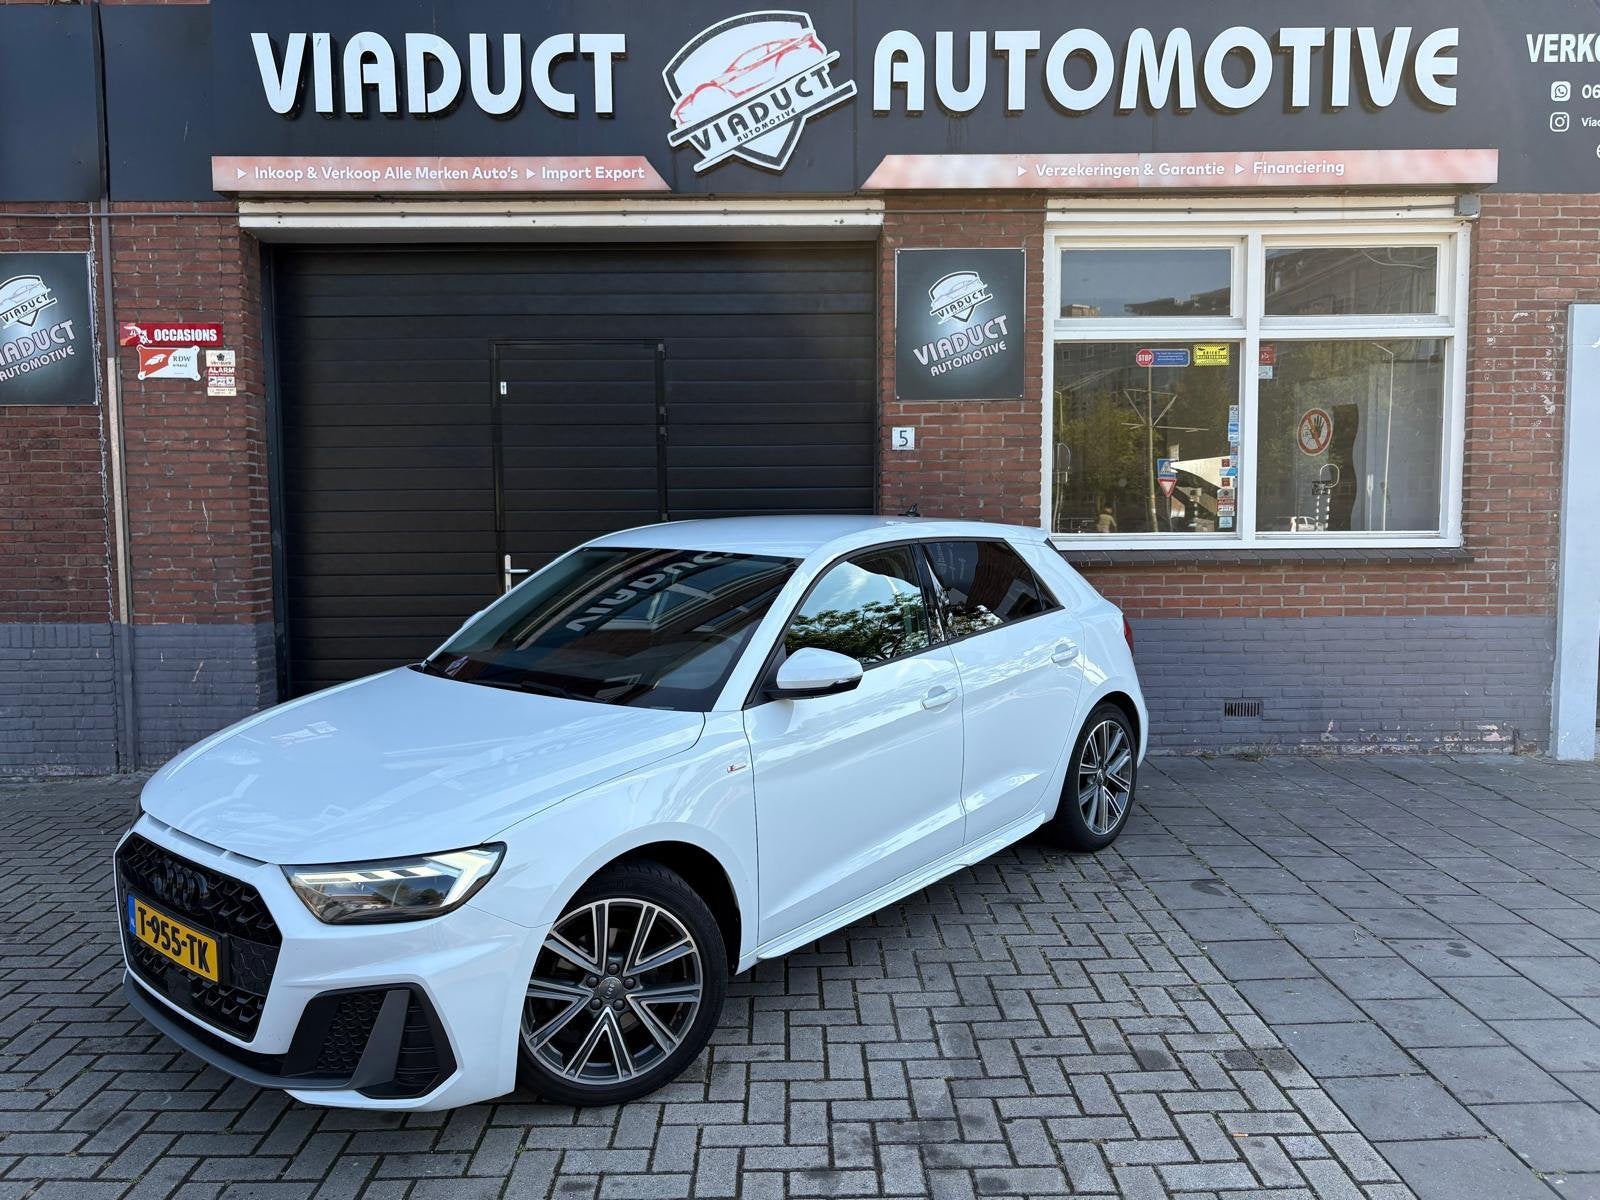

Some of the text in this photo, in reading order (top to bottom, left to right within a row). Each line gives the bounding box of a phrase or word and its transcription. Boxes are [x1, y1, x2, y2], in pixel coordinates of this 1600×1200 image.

[250, 31, 626, 114] VIADUCT
[873, 27, 1460, 111] AUTOMOTIVE
[691, 65, 831, 151] VIADUCT
[737, 107, 797, 142] AUTOMOTIVE
[255, 166, 519, 182] Inkoop & Verkoop Alle Merken Auto's
[542, 166, 645, 182] Import Export
[1036, 162, 1225, 179] Verzekeringen & Garantie
[1253, 160, 1345, 176] Financiering
[2, 293, 48, 322] VIADUCT
[938, 289, 985, 317] VIADUCT
[153, 328, 218, 342] OCCASIONS
[913, 314, 1009, 366] VIADUCT
[930, 340, 1007, 377] AUTOMOTIVE
[1138, 354, 1152, 362] STOP
[898, 430, 908, 447] 5
[138, 906, 210, 974] T-955-TK
